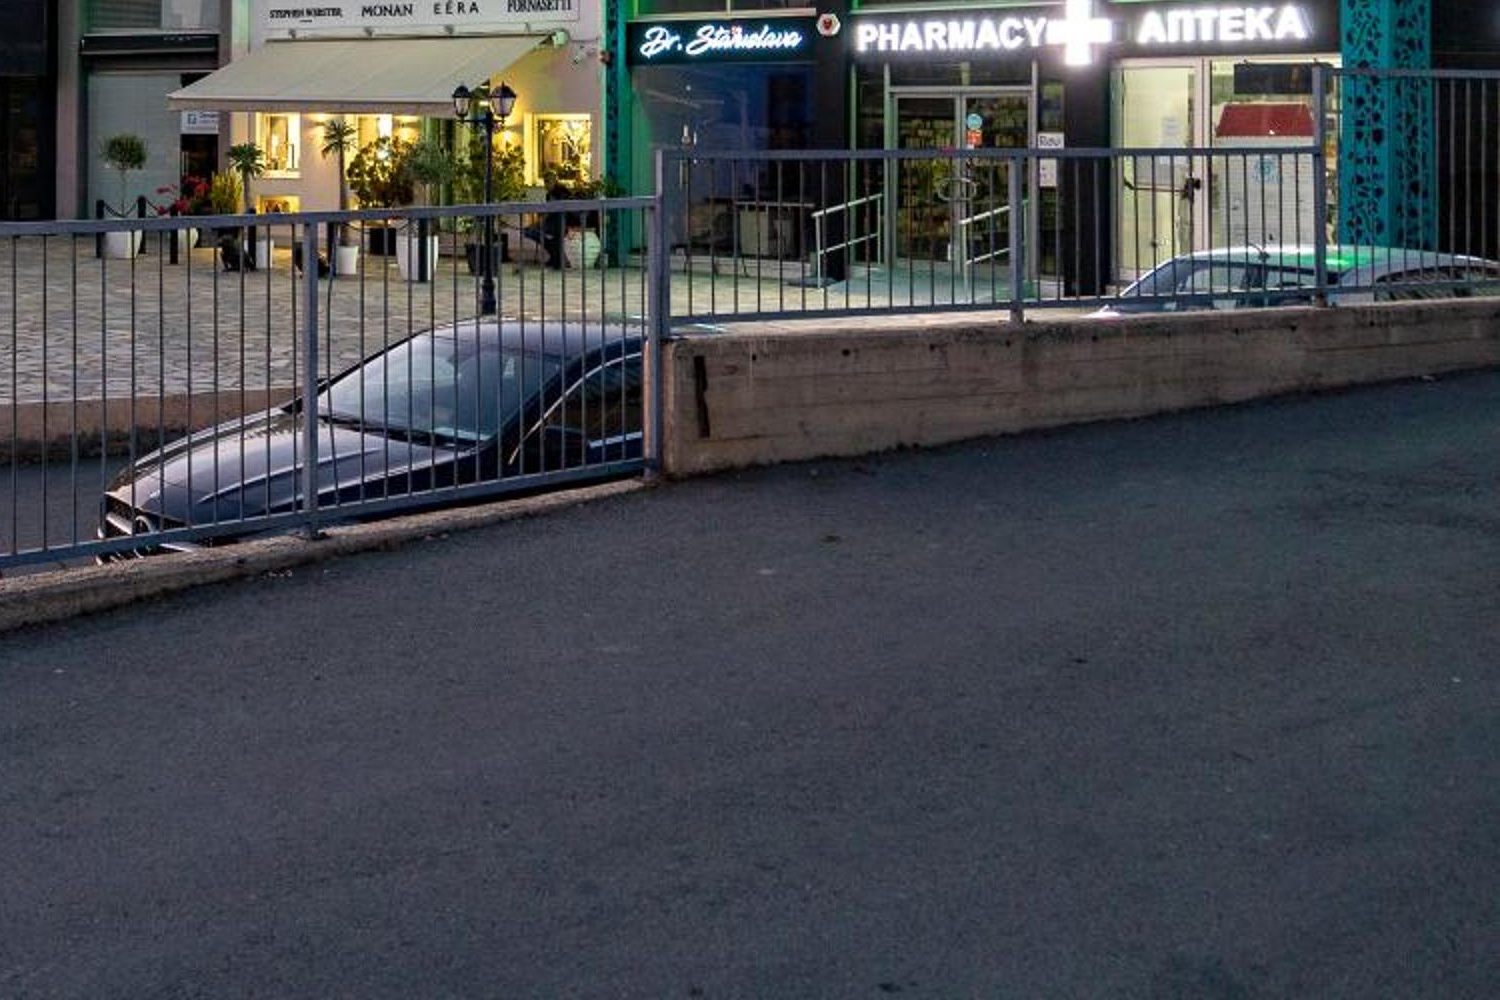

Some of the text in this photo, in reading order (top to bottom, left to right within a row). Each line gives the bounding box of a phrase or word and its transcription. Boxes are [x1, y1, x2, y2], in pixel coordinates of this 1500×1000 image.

[361, 3, 413, 17] MONAN
[1137, 3, 1314, 35] АПТЕКА
[640, 26, 683, 58] Dr.
[857, 18, 1047, 52] PHARMACY
